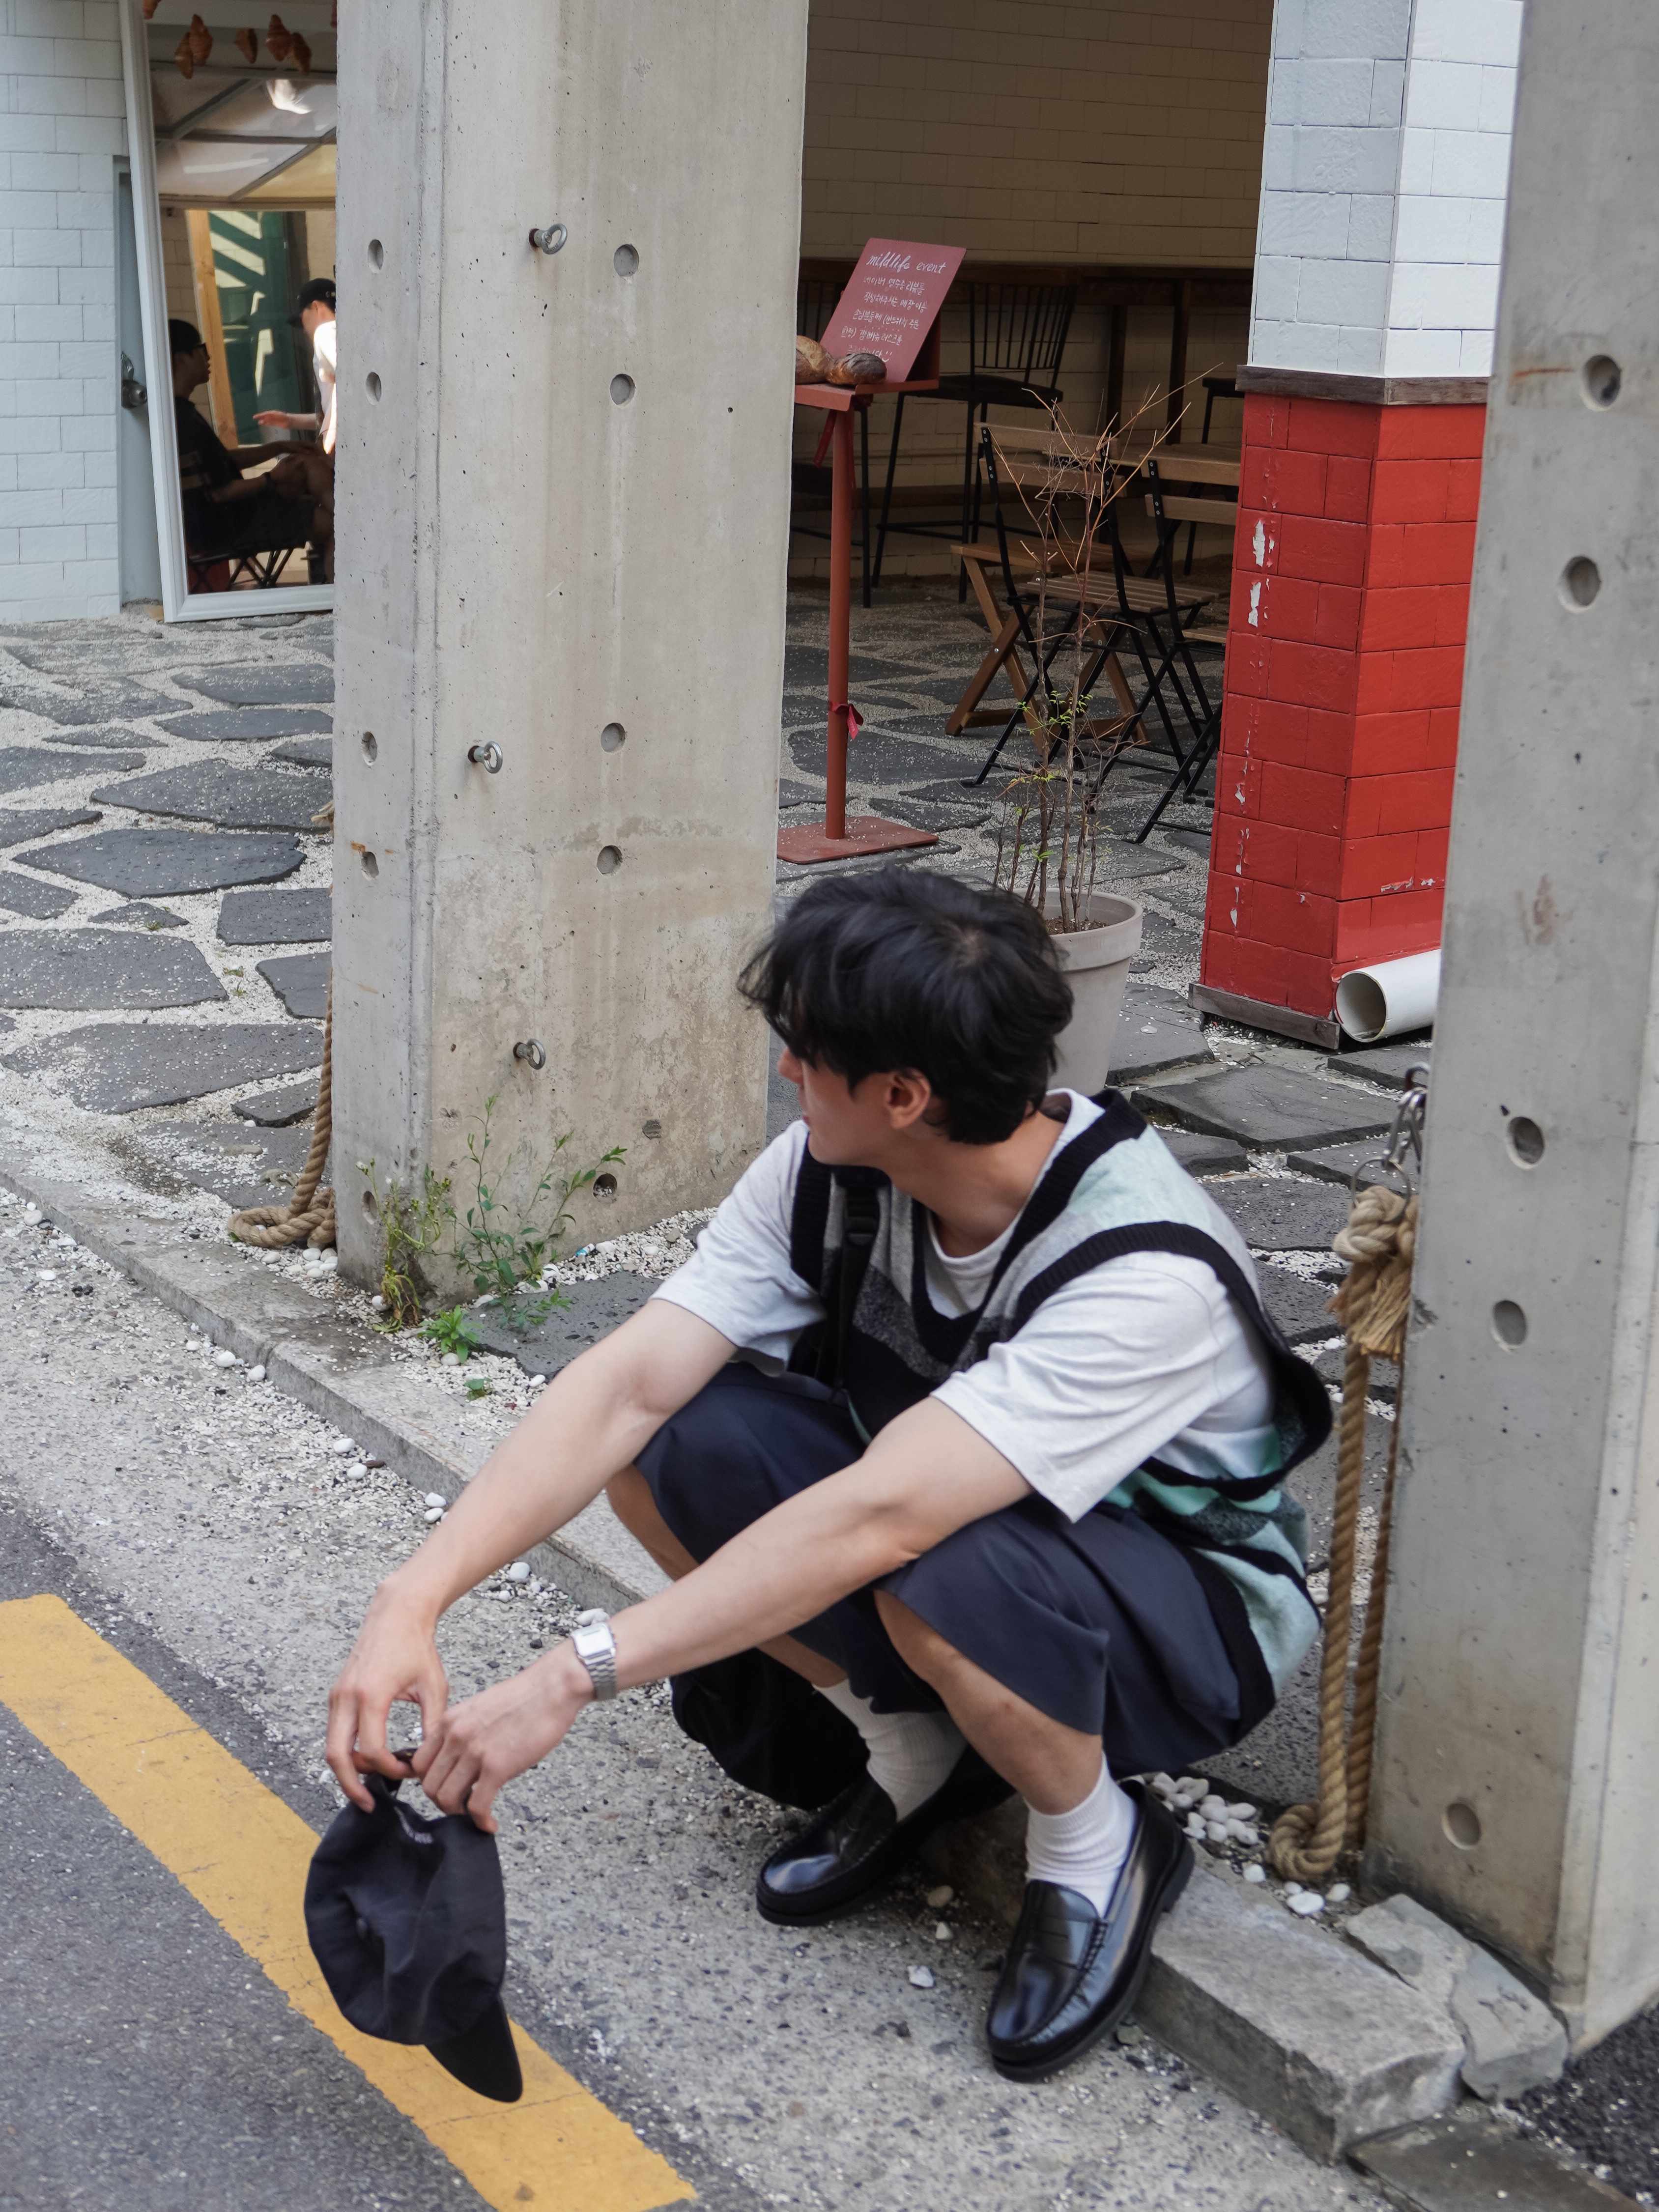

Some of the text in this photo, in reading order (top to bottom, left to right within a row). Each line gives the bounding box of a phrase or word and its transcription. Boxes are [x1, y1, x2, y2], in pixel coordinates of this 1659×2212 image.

[866, 251, 946, 274] mildlife event
[863, 276, 886, 286] 네이버
[908, 318, 919, 330] 주문
